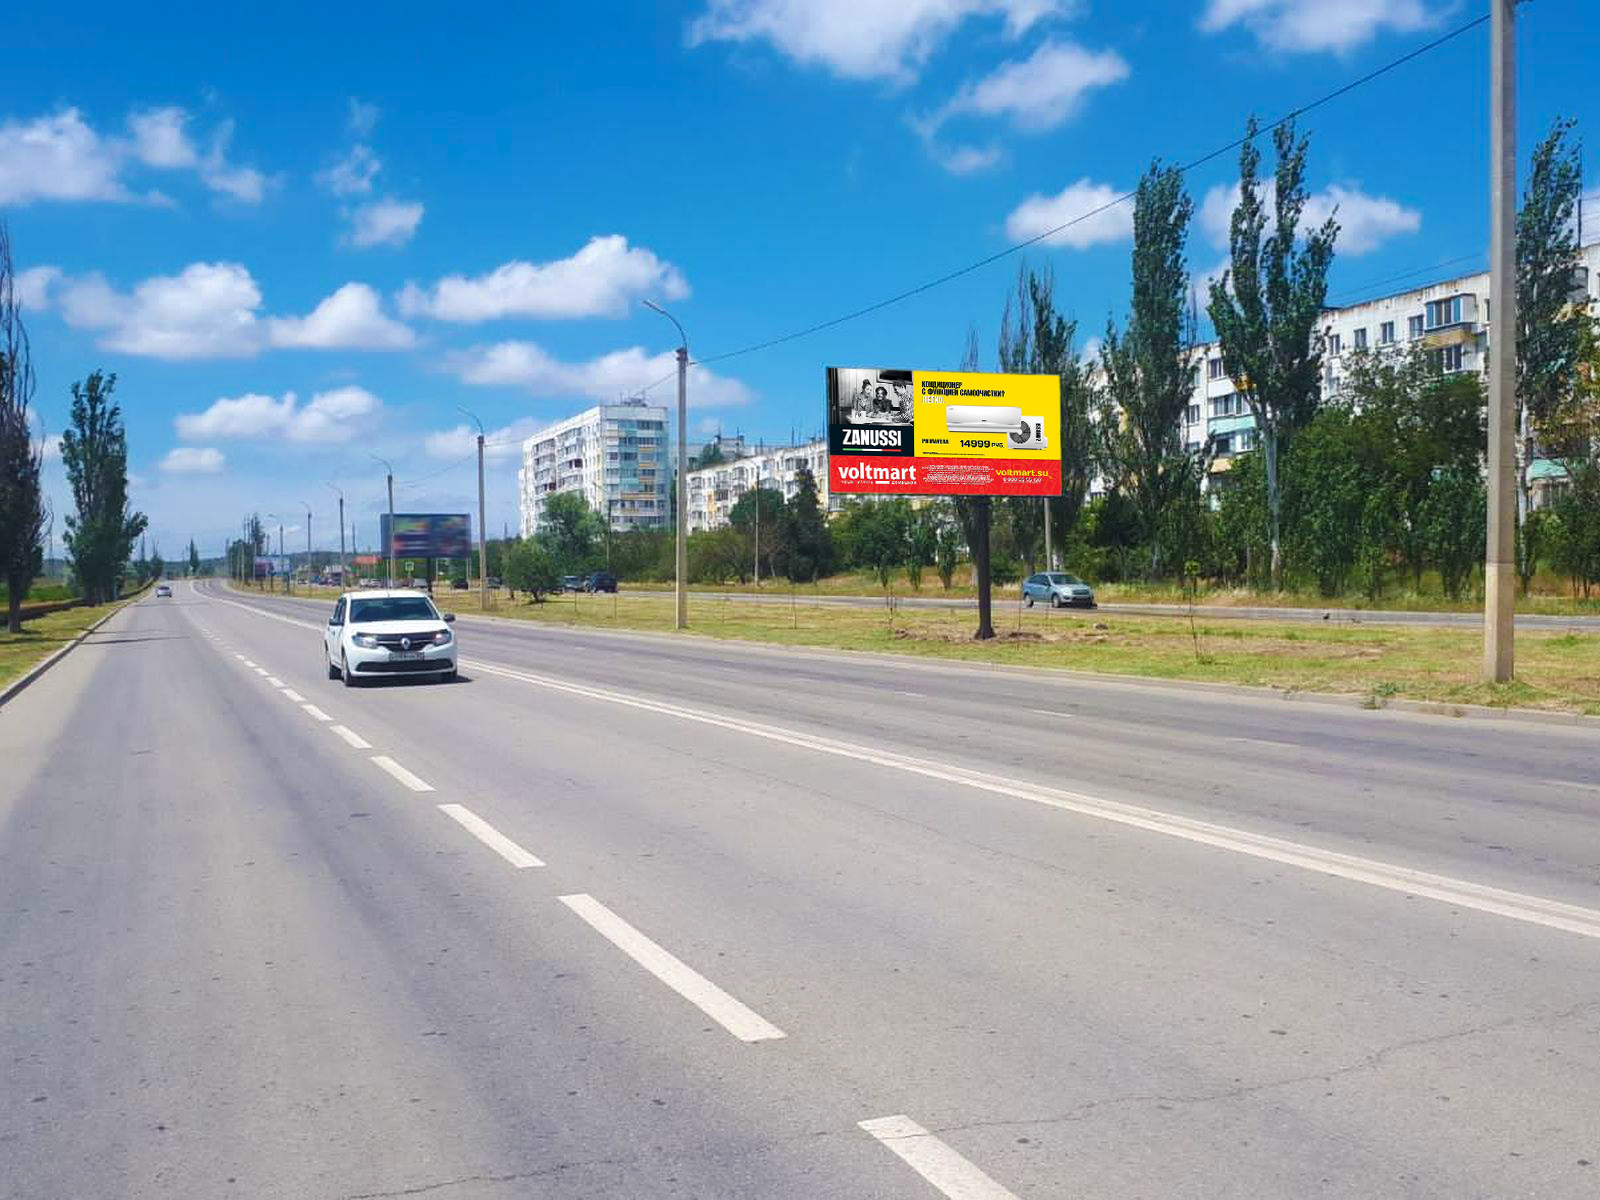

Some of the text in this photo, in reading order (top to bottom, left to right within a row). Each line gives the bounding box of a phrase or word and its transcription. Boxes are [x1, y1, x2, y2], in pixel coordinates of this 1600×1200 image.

[921, 387, 926, 395] С
[927, 387, 959, 396] ФУНКЦИЕЙ
[922, 395, 945, 403] ЛЕГКО.
[842, 429, 901, 447] ZANUSSI
[959, 439, 991, 448] 14999
[838, 463, 916, 480] voltmart
